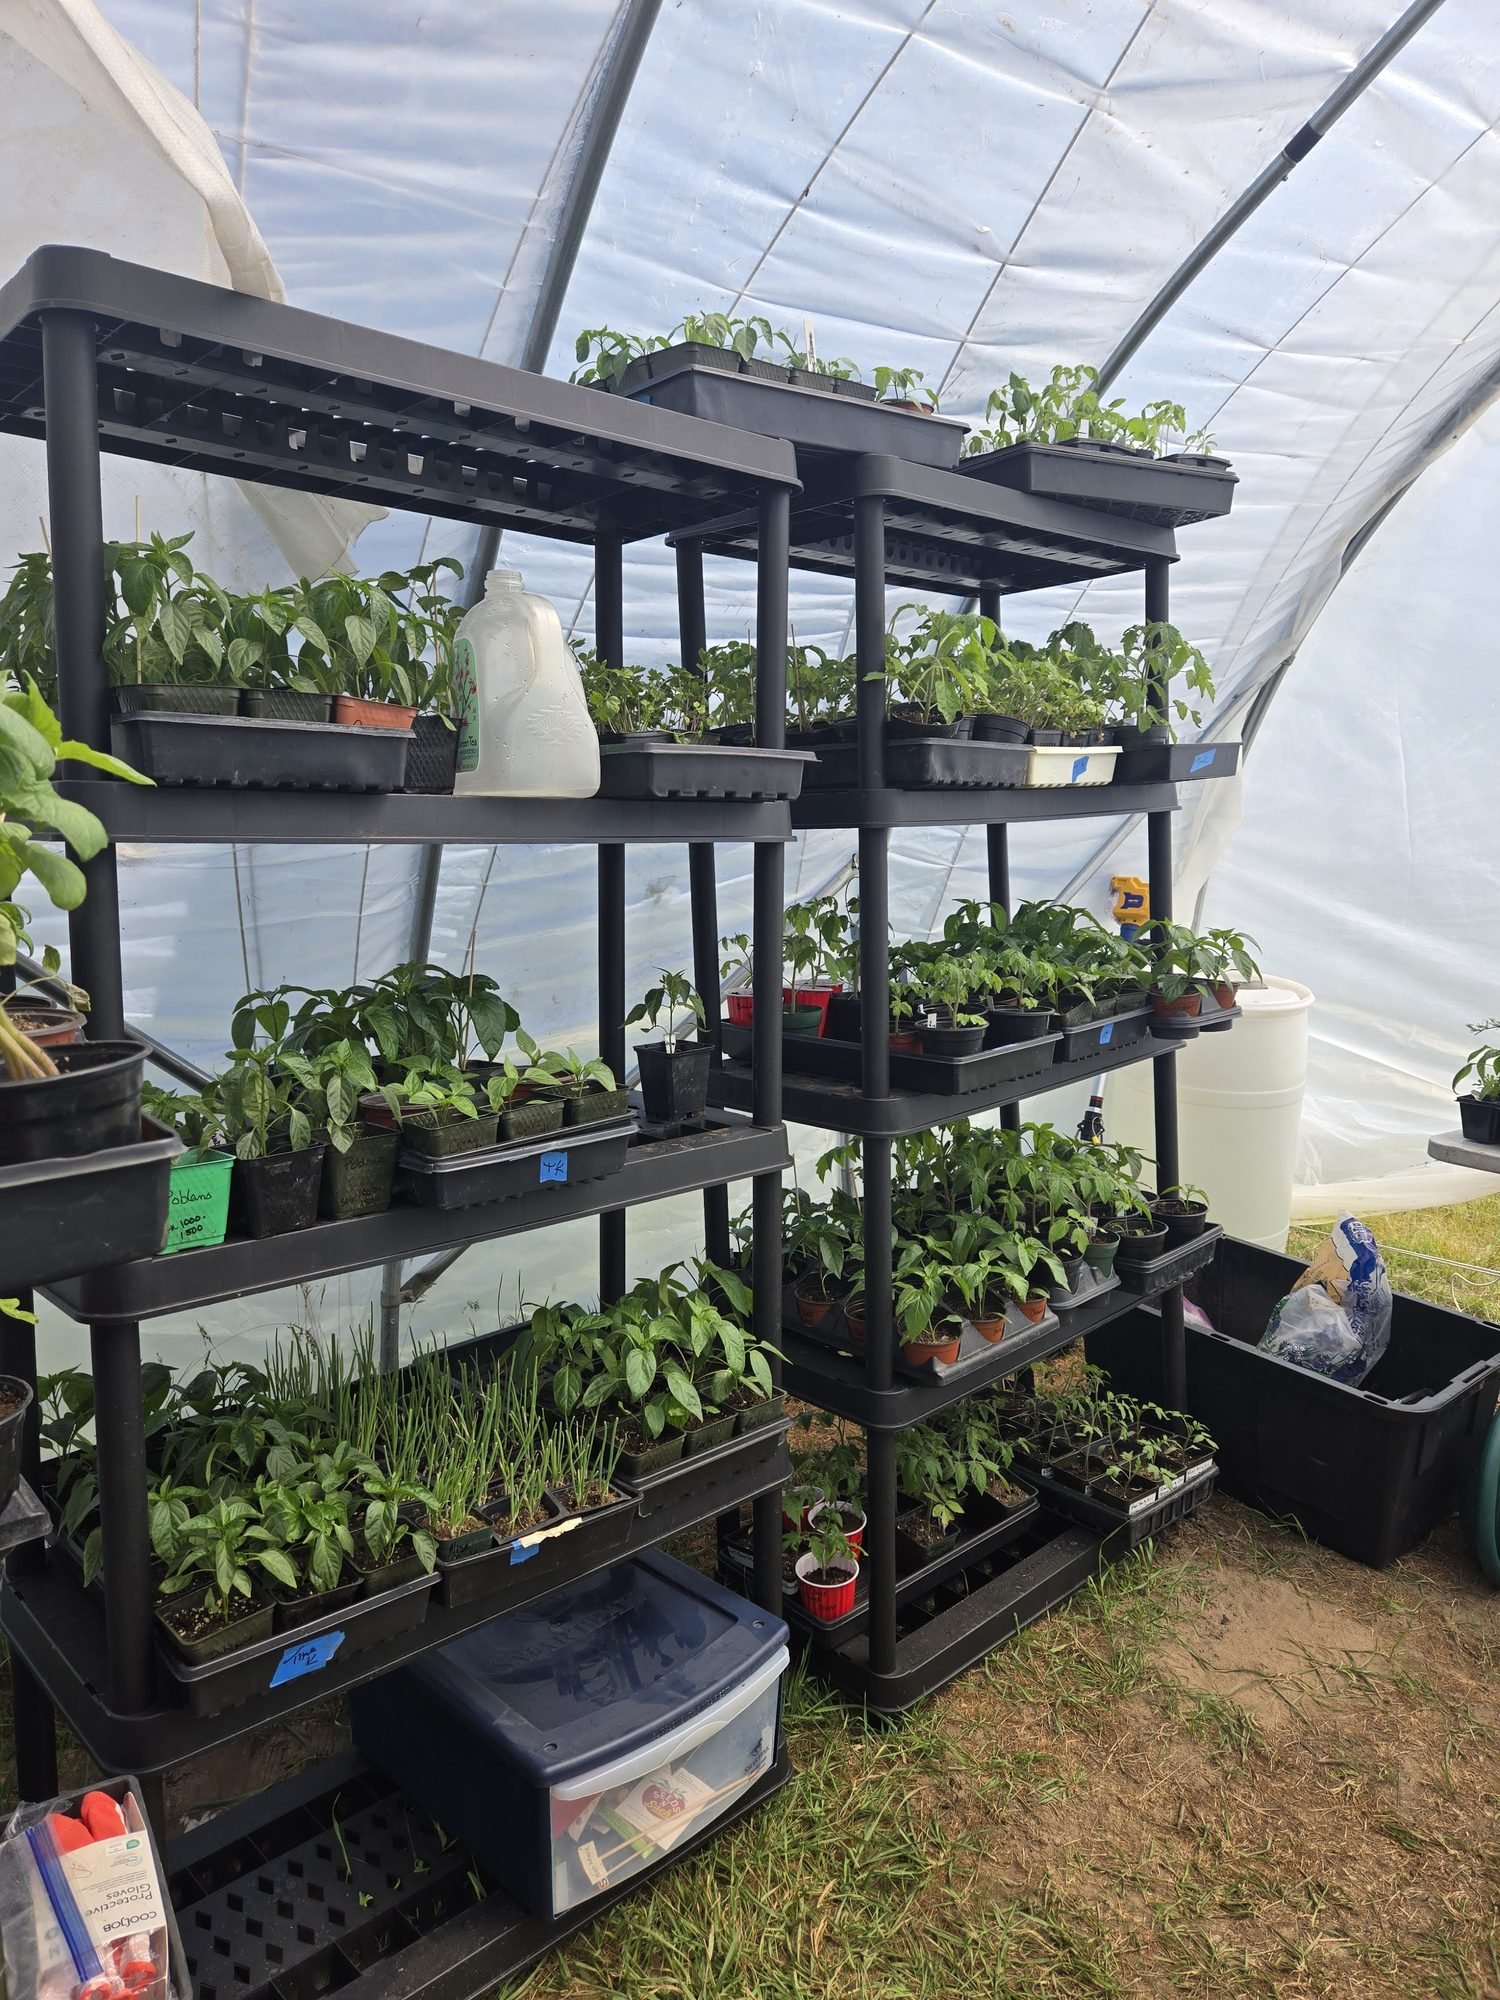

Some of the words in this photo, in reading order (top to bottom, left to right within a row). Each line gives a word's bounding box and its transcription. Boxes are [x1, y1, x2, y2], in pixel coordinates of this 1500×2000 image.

[653, 1790, 681, 1813] SEEDS
[106, 1883, 151, 1900] Gloves
[84, 1890, 153, 1918] Protective
